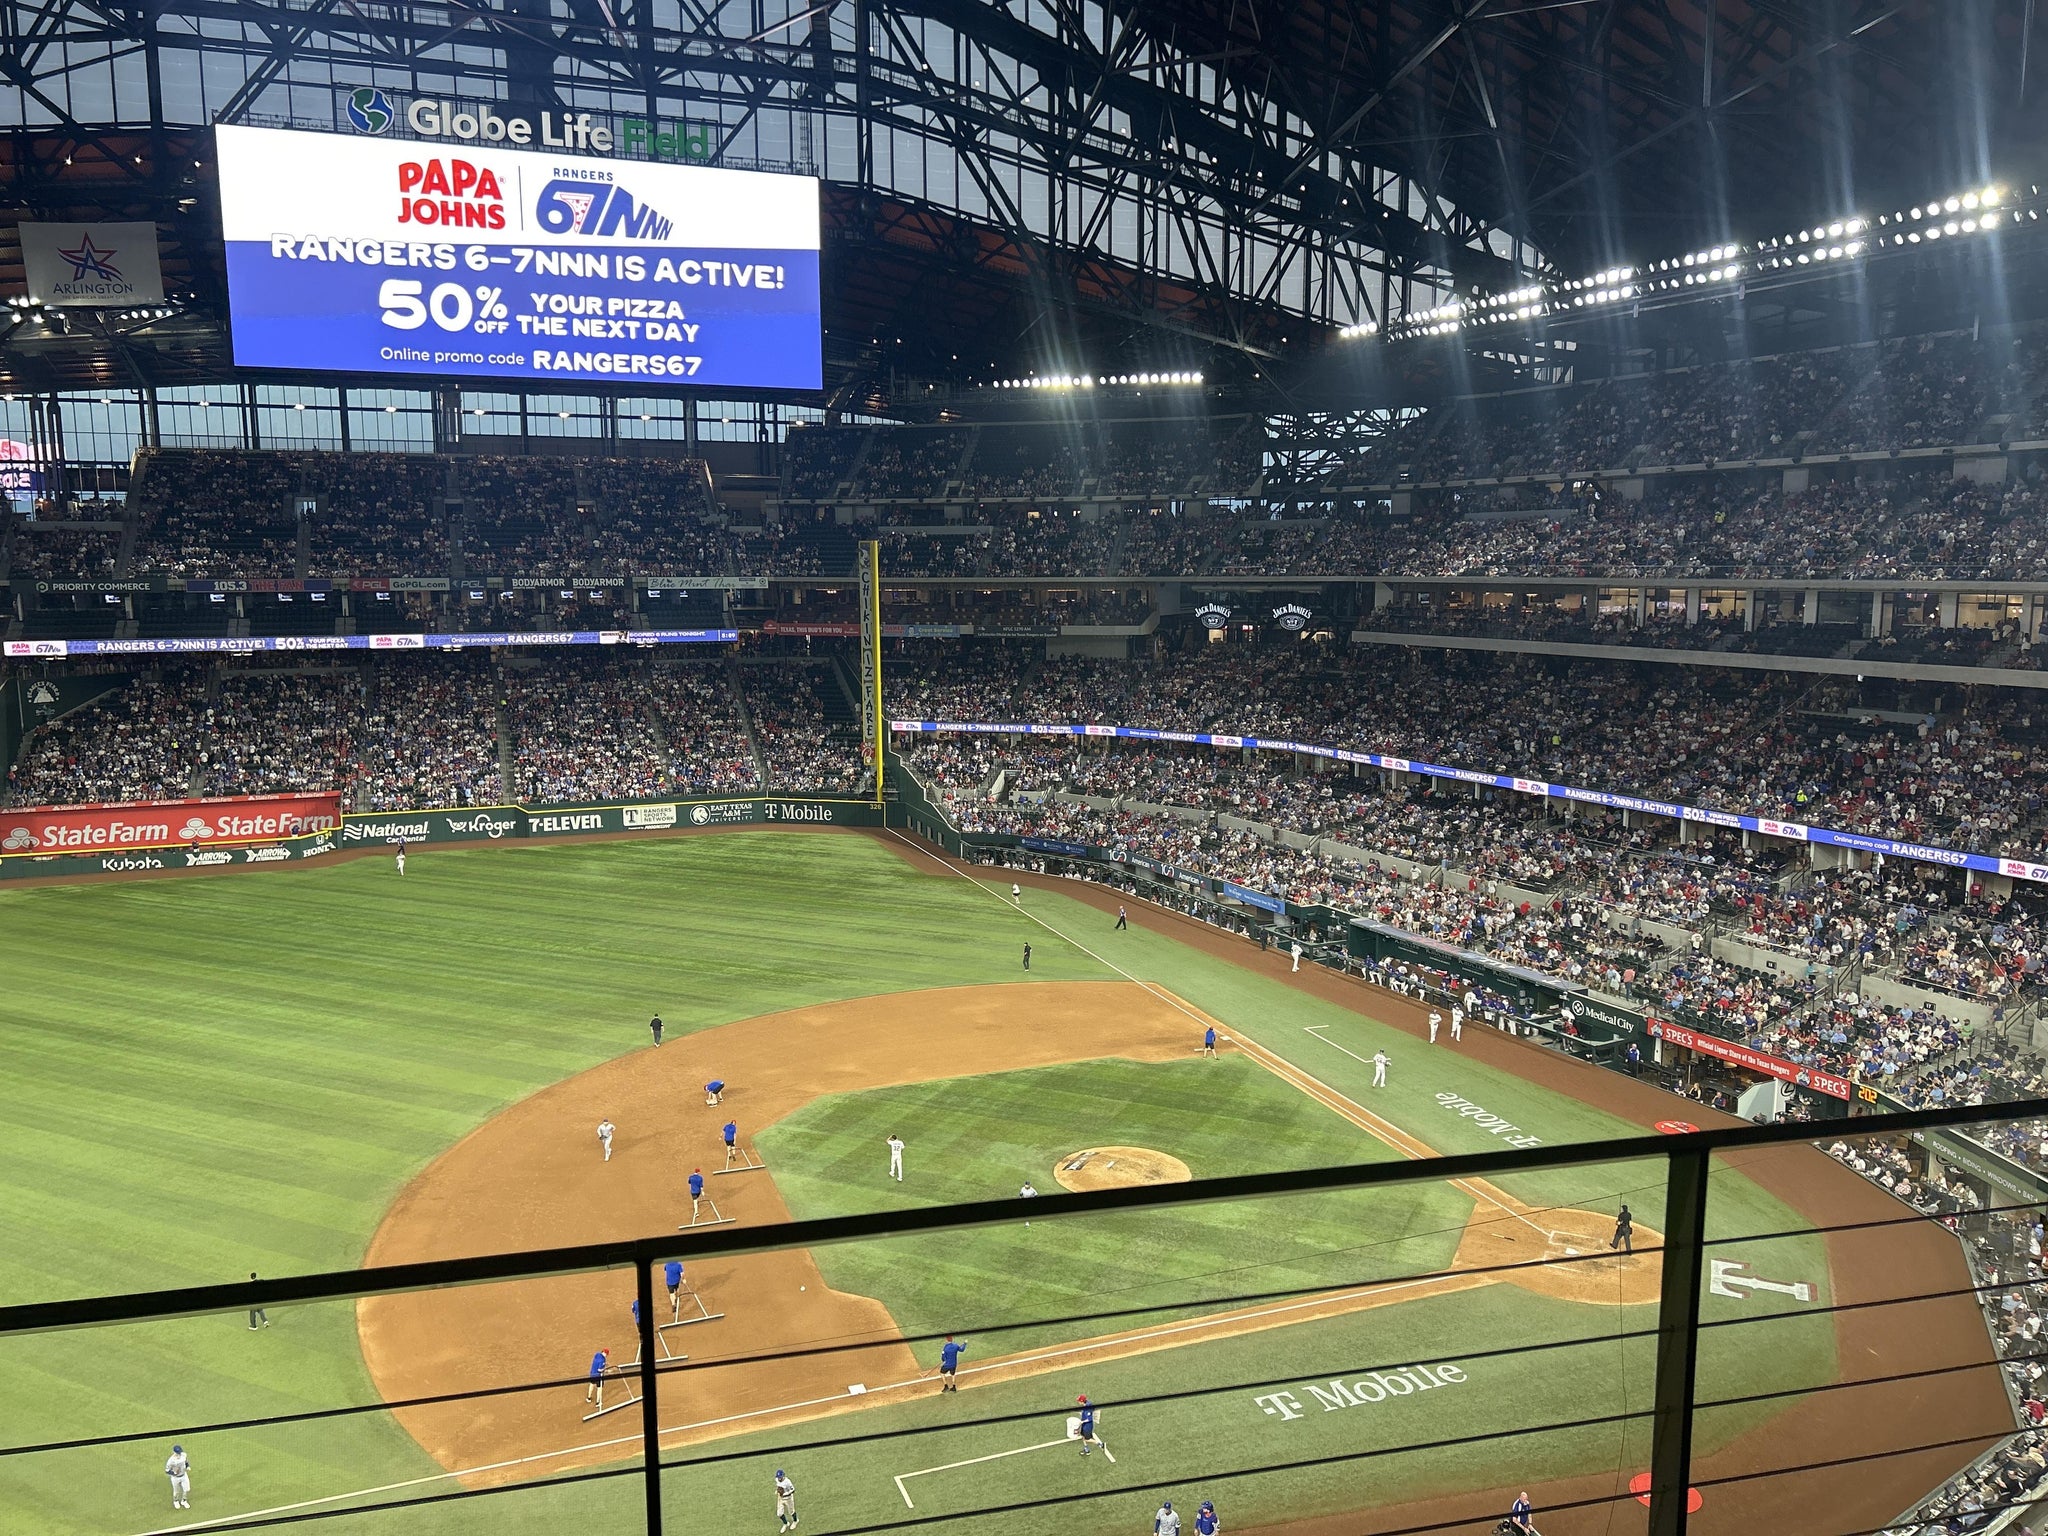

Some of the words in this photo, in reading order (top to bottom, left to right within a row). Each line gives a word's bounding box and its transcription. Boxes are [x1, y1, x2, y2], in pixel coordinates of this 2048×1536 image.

[407, 97, 532, 145] Globe
[541, 111, 613, 152] Life
[623, 118, 709, 160] Field
[398, 159, 503, 200] PAPA
[553, 168, 614, 182] RANGERS
[398, 197, 506, 230] JOHNS
[271, 233, 457, 270] RANGERS
[615, 256, 646, 280] IS
[653, 258, 785, 290] ACTIVE!
[53, 283, 133, 294] ARLINGTON
[378, 279, 508, 332] 50%
[531, 293, 602, 316] YOUR
[608, 298, 685, 320] PIZZA
[474, 320, 508, 335] OFF
[516, 314, 568, 336] THE
[573, 318, 641, 340] NEXT
[645, 322, 700, 343] DAY
[380, 347, 431, 362] Online
[434, 350, 483, 367] promo
[487, 351, 525, 367] code
[533, 349, 702, 377] RANGERS67
[53, 583, 96, 591] PRIORITY
[98, 582, 150, 591] COMMERCE
[214, 581, 248, 591] 105.3
[362, 580, 387, 589] PGL
[393, 581, 447, 589] GoPGL.com
[460, 580, 484, 588] PGL
[512, 578, 565, 587] BODYARMOR
[572, 578, 625, 587] BODYARMOR
[650, 577, 676, 588] Blue
[679, 578, 710, 588] Mint
[1194, 606, 1209, 618] JACK
[1208, 602, 1232, 618] DANIEL'S
[1272, 608, 1288, 619] JACK
[1287, 603, 1313, 620] DANIEL'S
[97, 642, 155, 651] RANGERS
[207, 640, 217, 649] IS
[220, 639, 266, 649] ACTIVE!
[451, 636, 469, 644] Online
[471, 637, 490, 645] promo
[507, 633, 574, 644] RANGERS67
[1256, 740, 1288, 750] RANGERS
[1455, 770, 1498, 784] RANGERS67
[730, 802, 753, 810] TEXAS
[1565, 788, 1602, 802] RANGERS
[1634, 800, 1643, 809] IS
[1643, 801, 1676, 815] ACTIVE!
[625, 809, 639, 824] T
[711, 815, 753, 823] UNIVERSITY
[722, 809, 741, 817] A&M
[781, 803, 833, 821] Mobile
[363, 821, 429, 837] National
[469, 814, 516, 839] Kroger
[386, 836, 399, 844] Car
[401, 835, 426, 843] Rental
[198, 851, 228, 862] ARROW
[256, 848, 286, 859] ARROW
[1833, 834, 1853, 845] Online
[1853, 839, 1873, 849] promo
[1873, 841, 1890, 851] code
[1891, 842, 1968, 865] RANGERS67
[103, 856, 163, 871] Kubota
[1131, 856, 1150, 868] American
[2007, 863, 2026, 871] PAPA
[1178, 872, 1199, 885] American
[1585, 1007, 1617, 1027] Medical
[1617, 1017, 1635, 1033] City
[1666, 1028, 1693, 1045] SPEC'S
[1697, 1039, 1714, 1051] Official
[1714, 1045, 1728, 1056] Liquor
[1729, 1049, 1742, 1059] Store
[1741, 1052, 1748, 1060] of
[1748, 1054, 1756, 1063] the
[1756, 1057, 1770, 1069] Texas
[1770, 1062, 1790, 1076] Rangers
[1814, 1076, 1847, 1096] SPEC'S
[1435, 1092, 1522, 1135] Mobile
[1932, 1140, 1957, 1159] ROOFING
[1987, 1171, 2017, 1192] WINDOWS
[1301, 1363, 1468, 1412] Mobile
